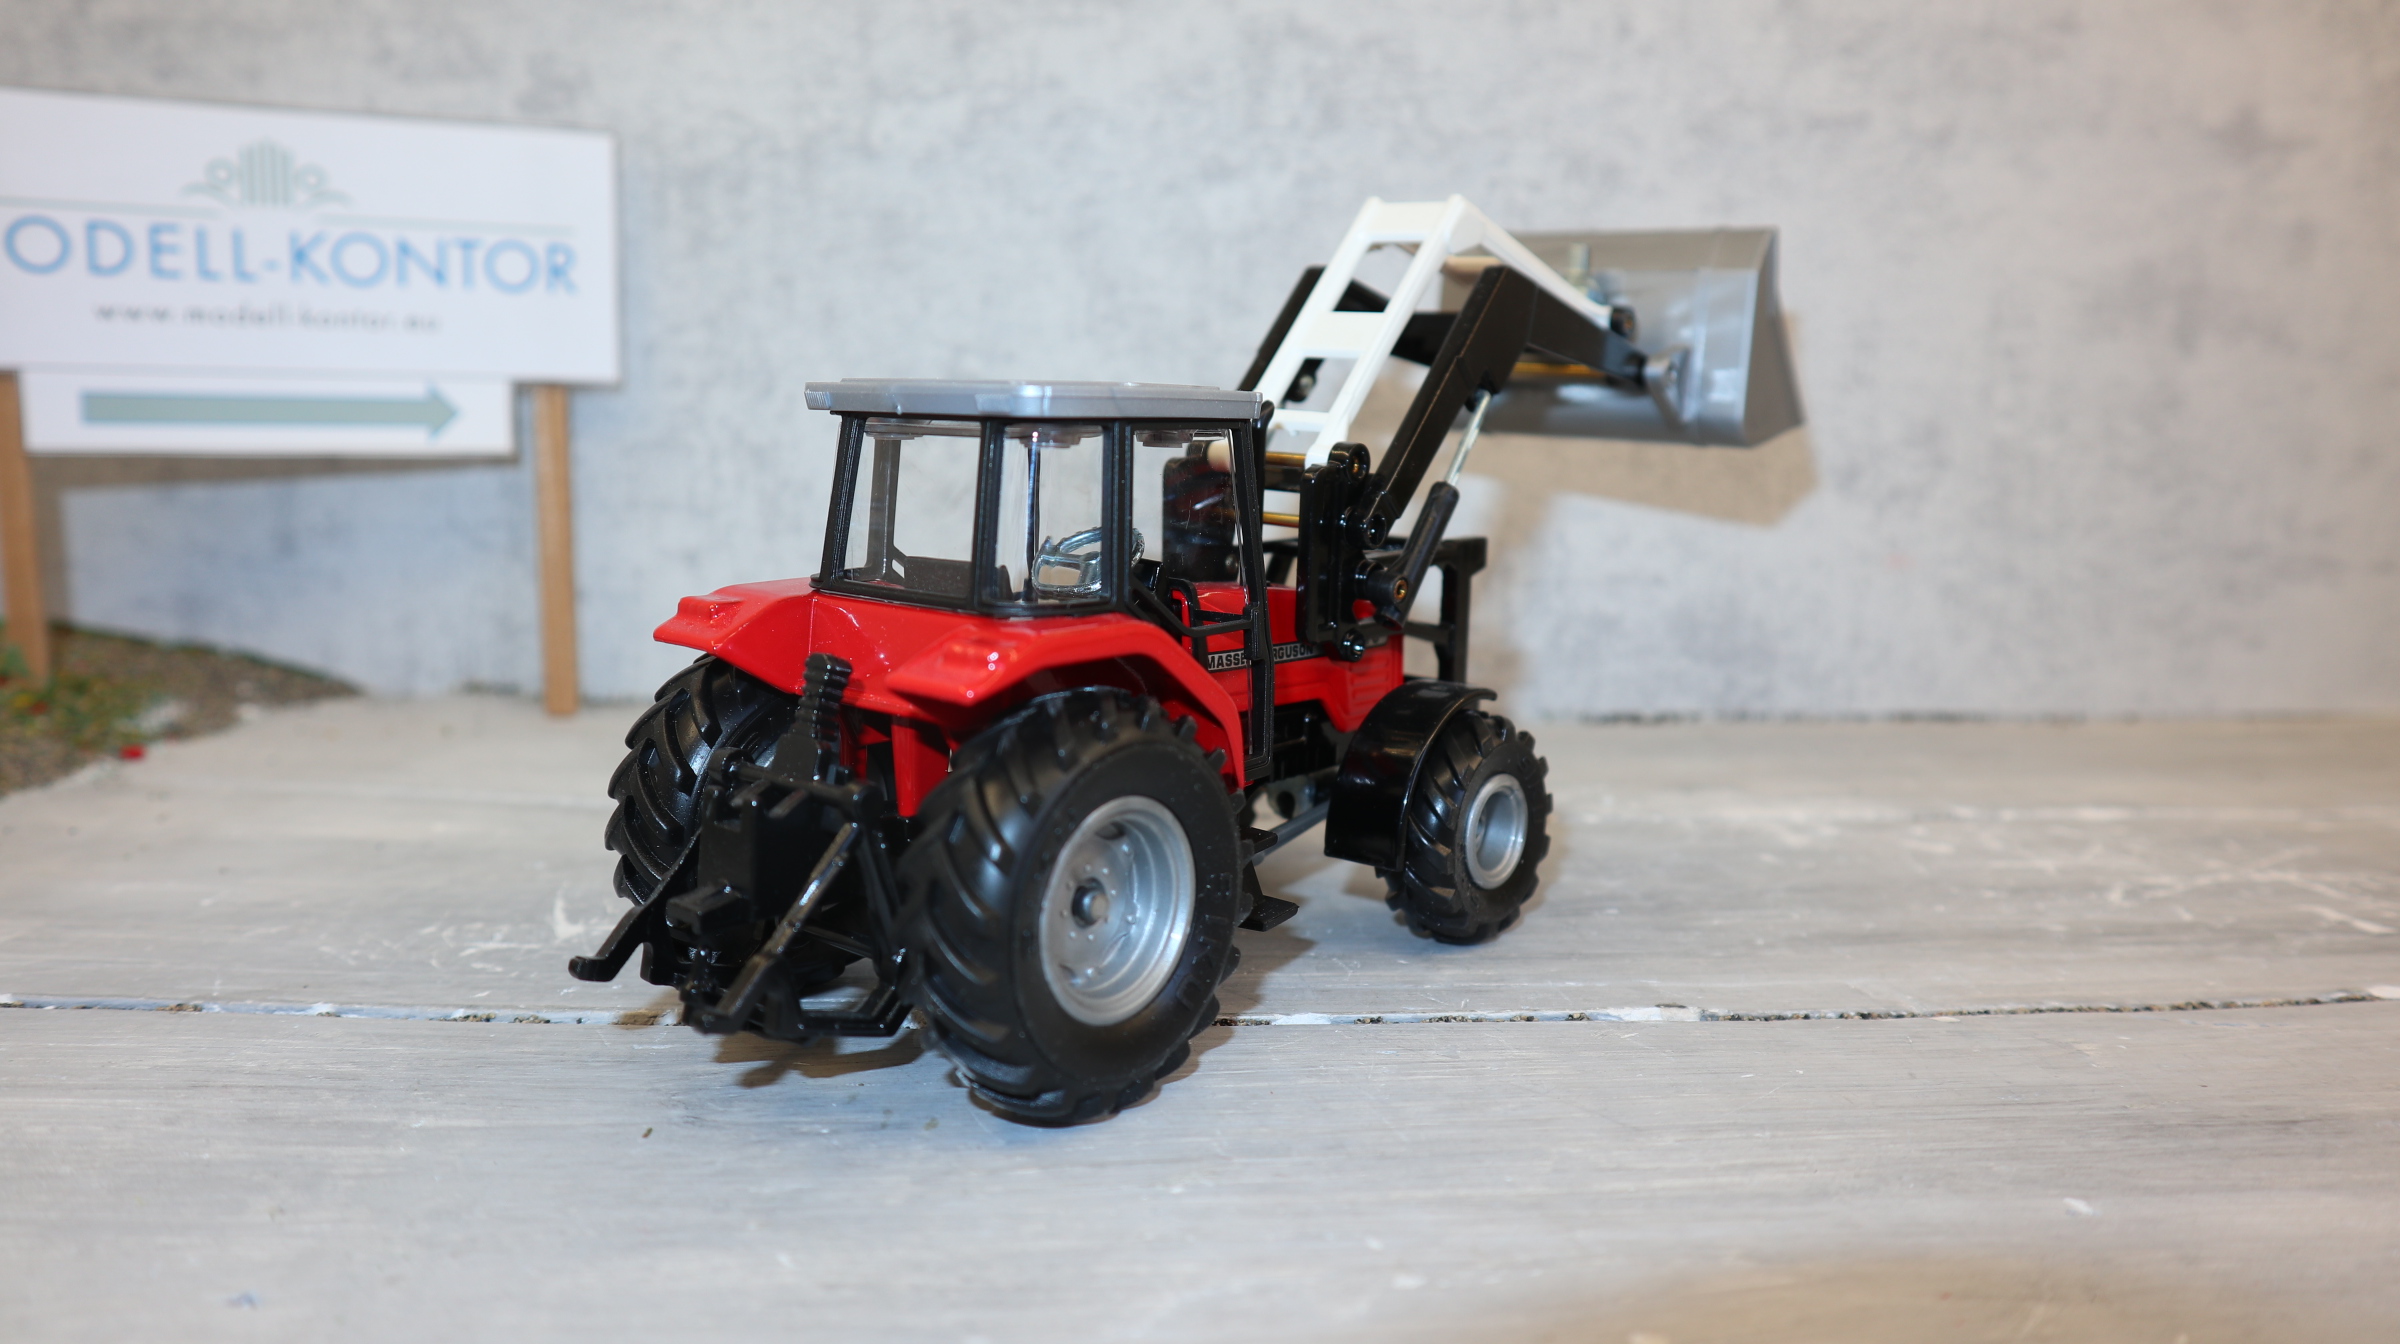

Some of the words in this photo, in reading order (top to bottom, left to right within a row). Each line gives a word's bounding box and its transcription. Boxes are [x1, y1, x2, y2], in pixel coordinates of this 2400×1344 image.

[3, 214, 578, 295] ODELL-KONTOR
[1208, 652, 1246, 668] MASSE
[1273, 643, 1313, 660] RGUSON
